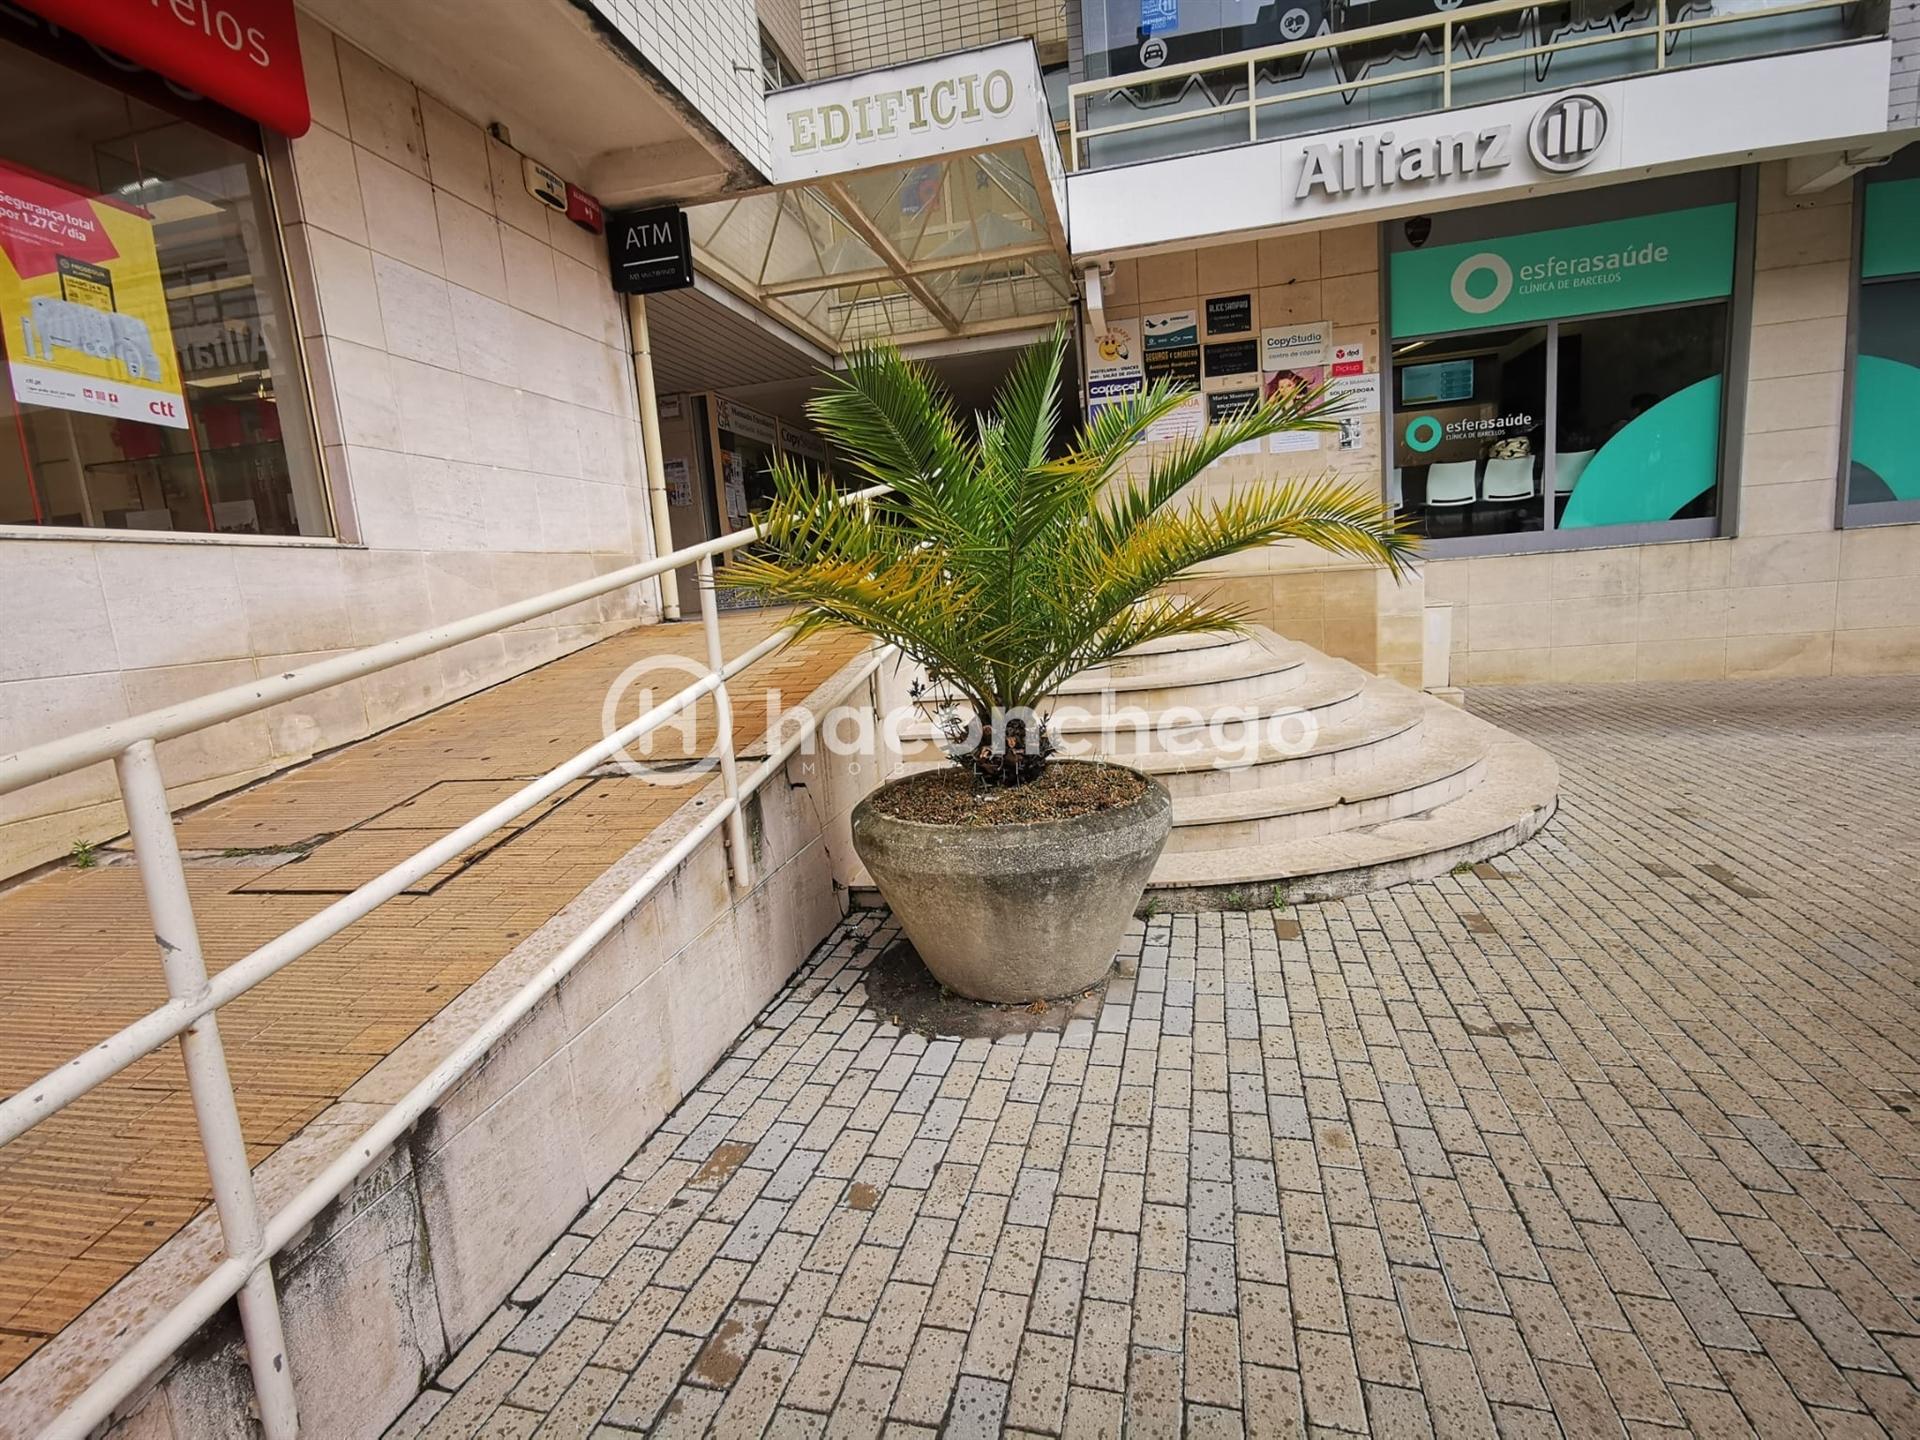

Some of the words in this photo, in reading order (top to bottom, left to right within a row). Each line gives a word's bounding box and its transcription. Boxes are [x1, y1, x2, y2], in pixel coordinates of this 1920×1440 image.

[150, 0, 270, 67] eios
[787, 69, 1015, 152] EDIFICIO
[1295, 124, 1513, 199] Allianz
[65, 214, 95, 232] total
[626, 221, 673, 250] ATM
[1519, 243, 1670, 281] esferasaúde
[1519, 279, 1555, 295] CLÍNICA
[1557, 279, 1569, 290] DE
[1573, 272, 1622, 288] BARCELOS
[1267, 333, 1322, 347] CopyStudio
[1347, 349, 1360, 357] dpd
[150, 400, 176, 418] ctt
[1446, 413, 1532, 432] esferasaúde
